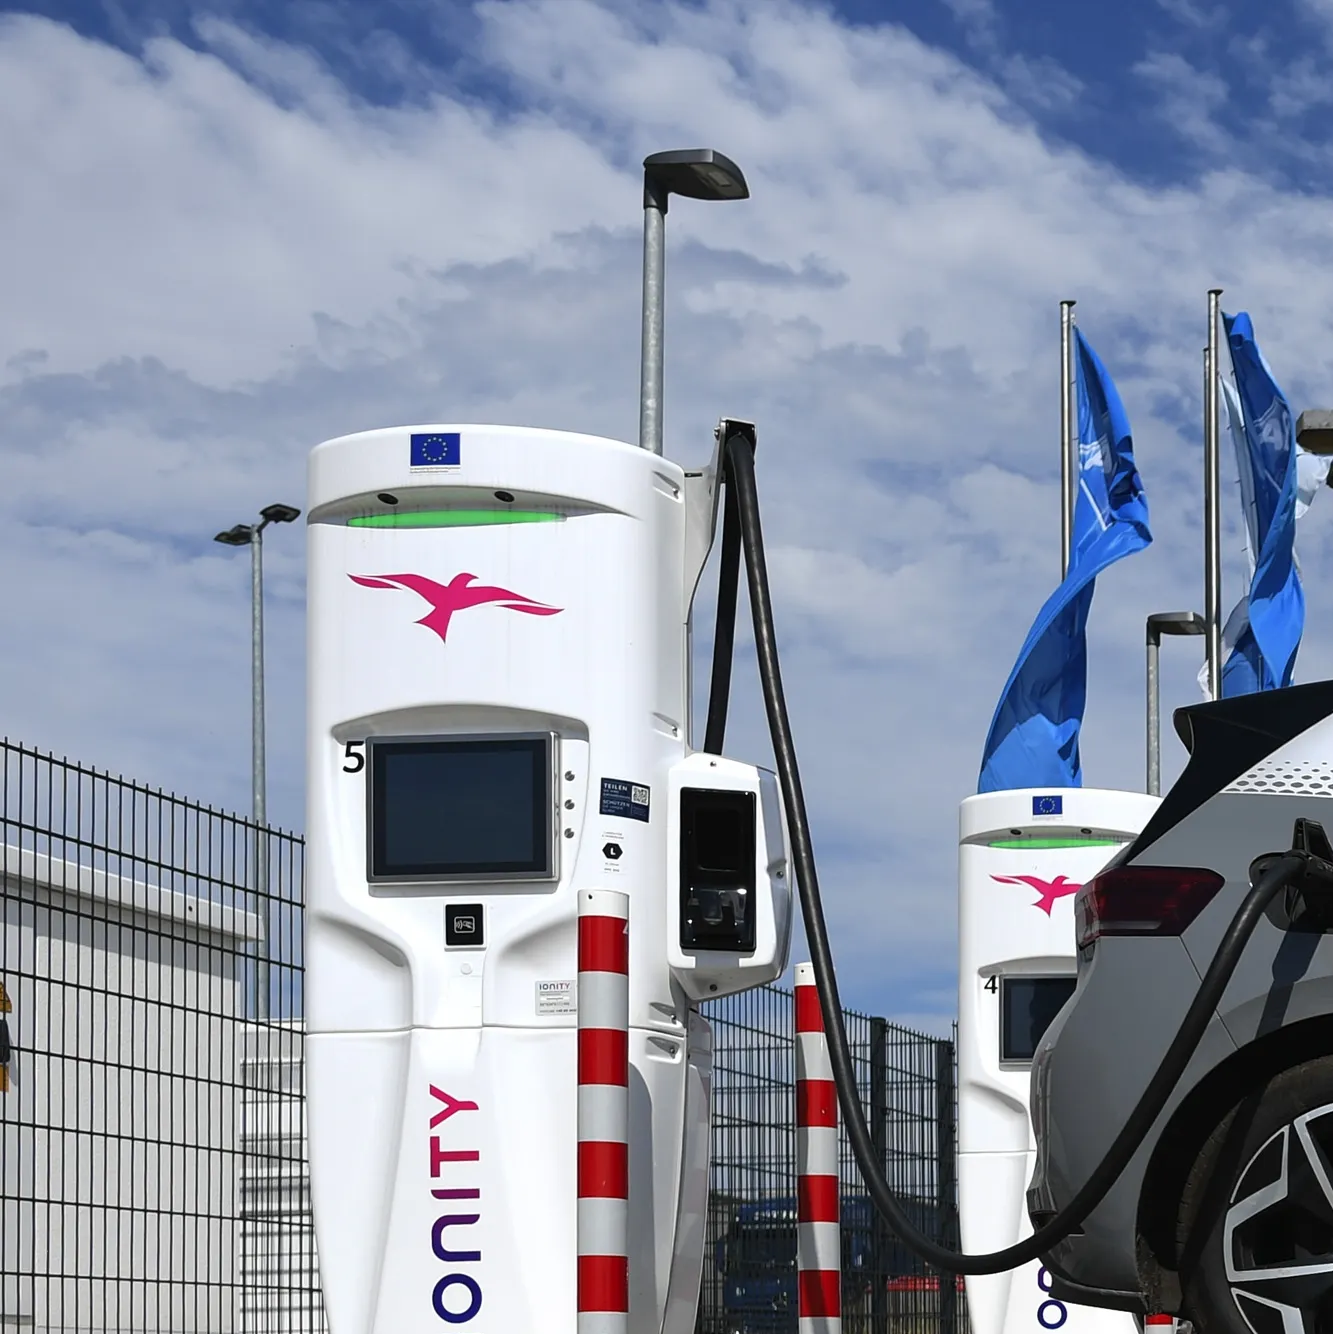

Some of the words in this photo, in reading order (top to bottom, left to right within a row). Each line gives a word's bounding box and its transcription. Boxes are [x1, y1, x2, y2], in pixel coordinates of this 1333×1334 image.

[342, 740, 365, 773] 5
[604, 783, 628, 791] TEILEN
[610, 847, 616, 855] L
[539, 983, 571, 991] IONITY
[984, 974, 998, 994] 4
